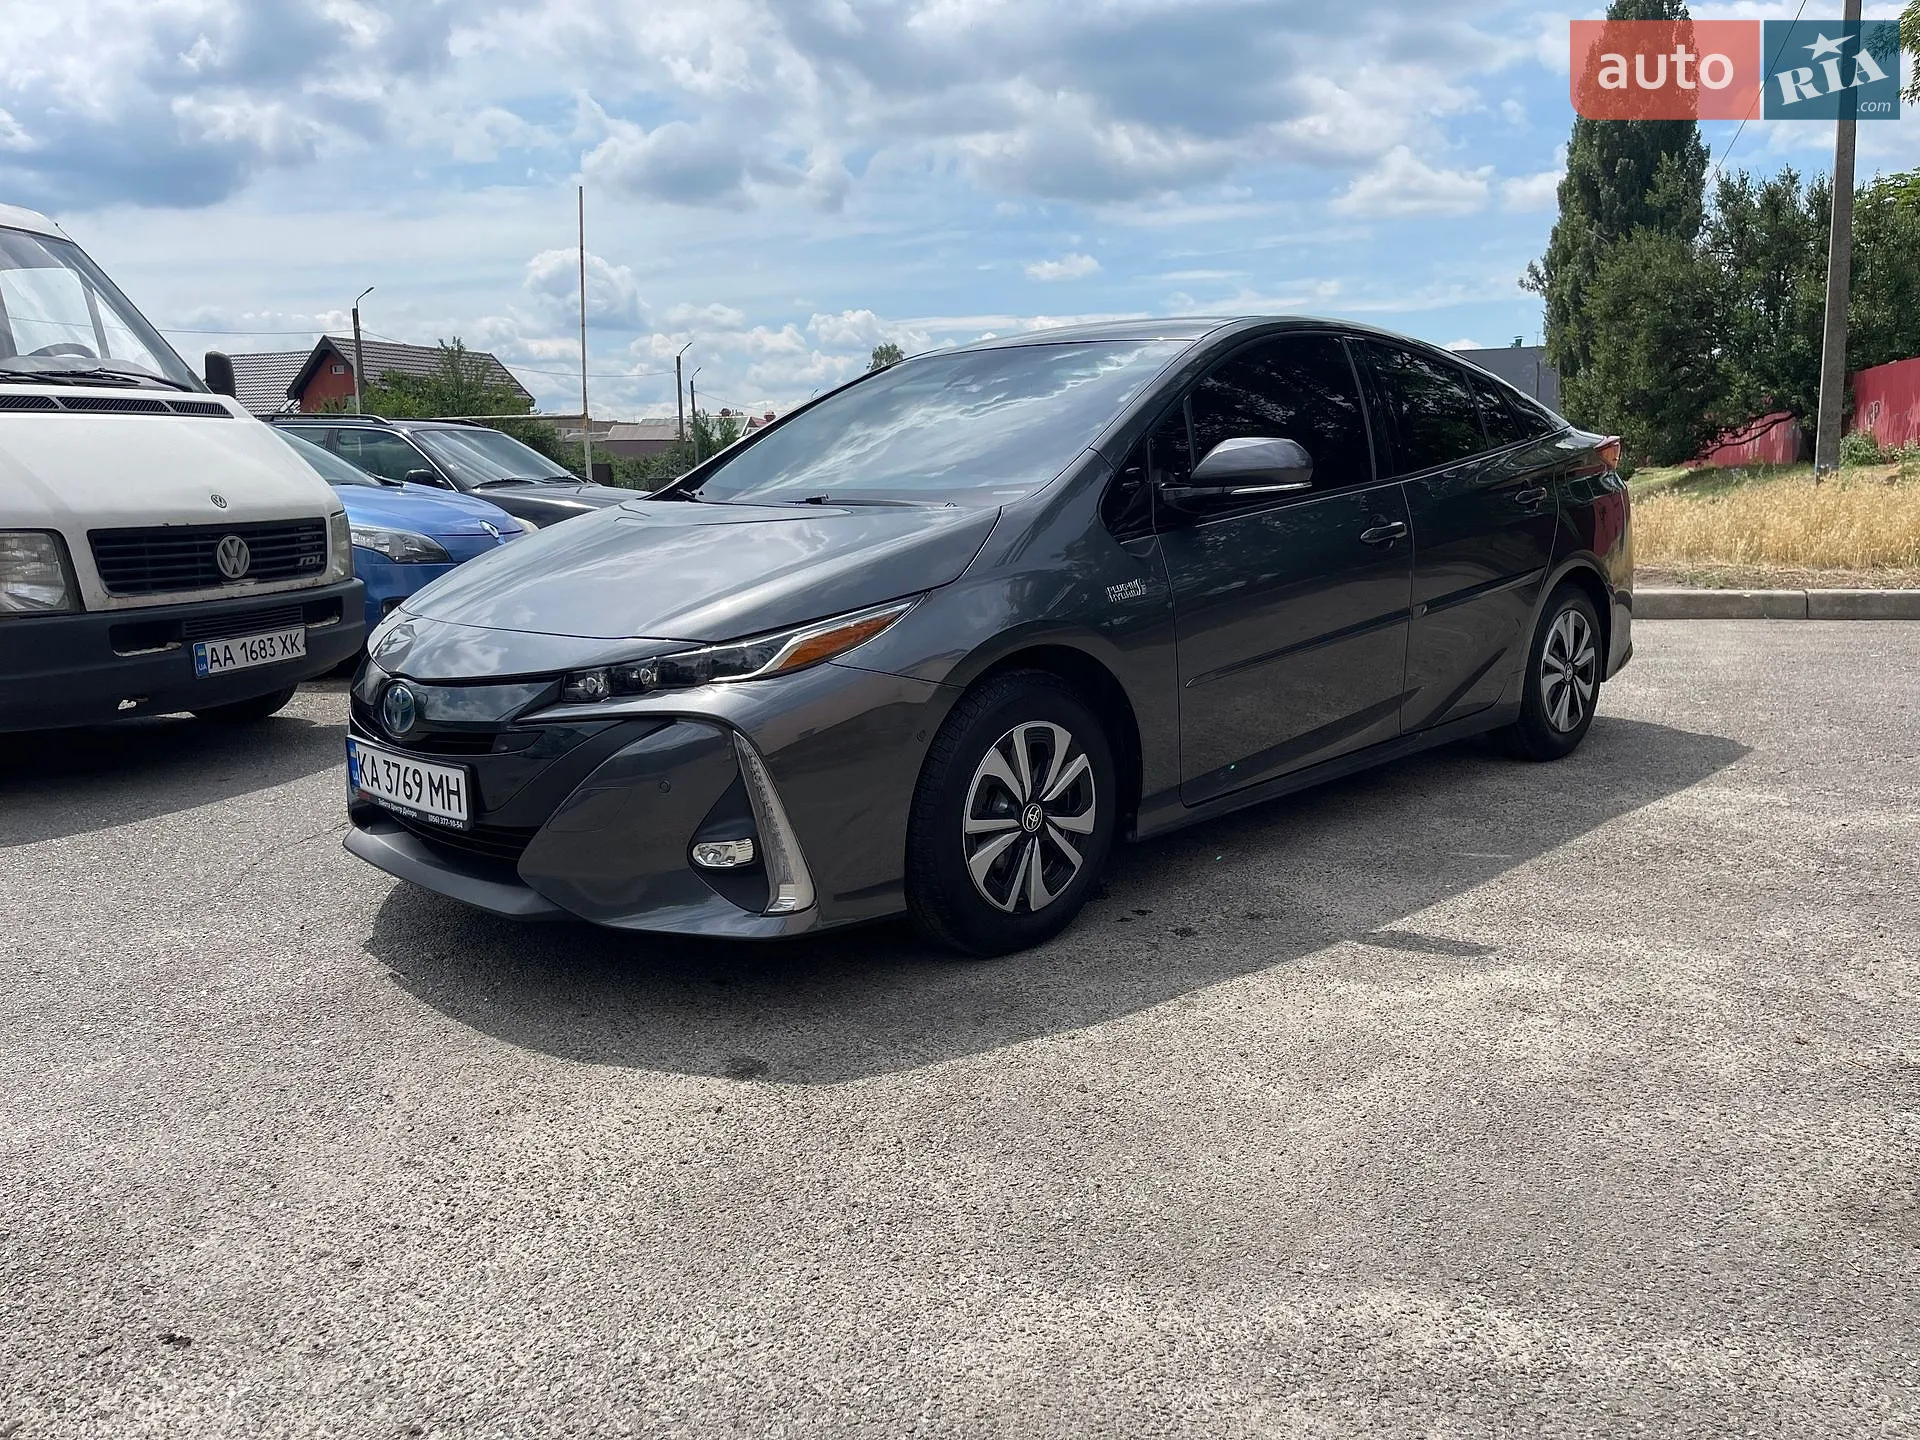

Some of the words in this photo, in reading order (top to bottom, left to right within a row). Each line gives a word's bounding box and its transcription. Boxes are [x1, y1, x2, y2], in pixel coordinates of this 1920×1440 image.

[198, 663, 208, 671] UA
[209, 645, 236, 669] AA
[240, 637, 276, 662] 1683
[278, 632, 301, 656] XK
[357, 750, 381, 791] KA
[383, 759, 423, 803] 3769
[428, 771, 462, 813] MH
